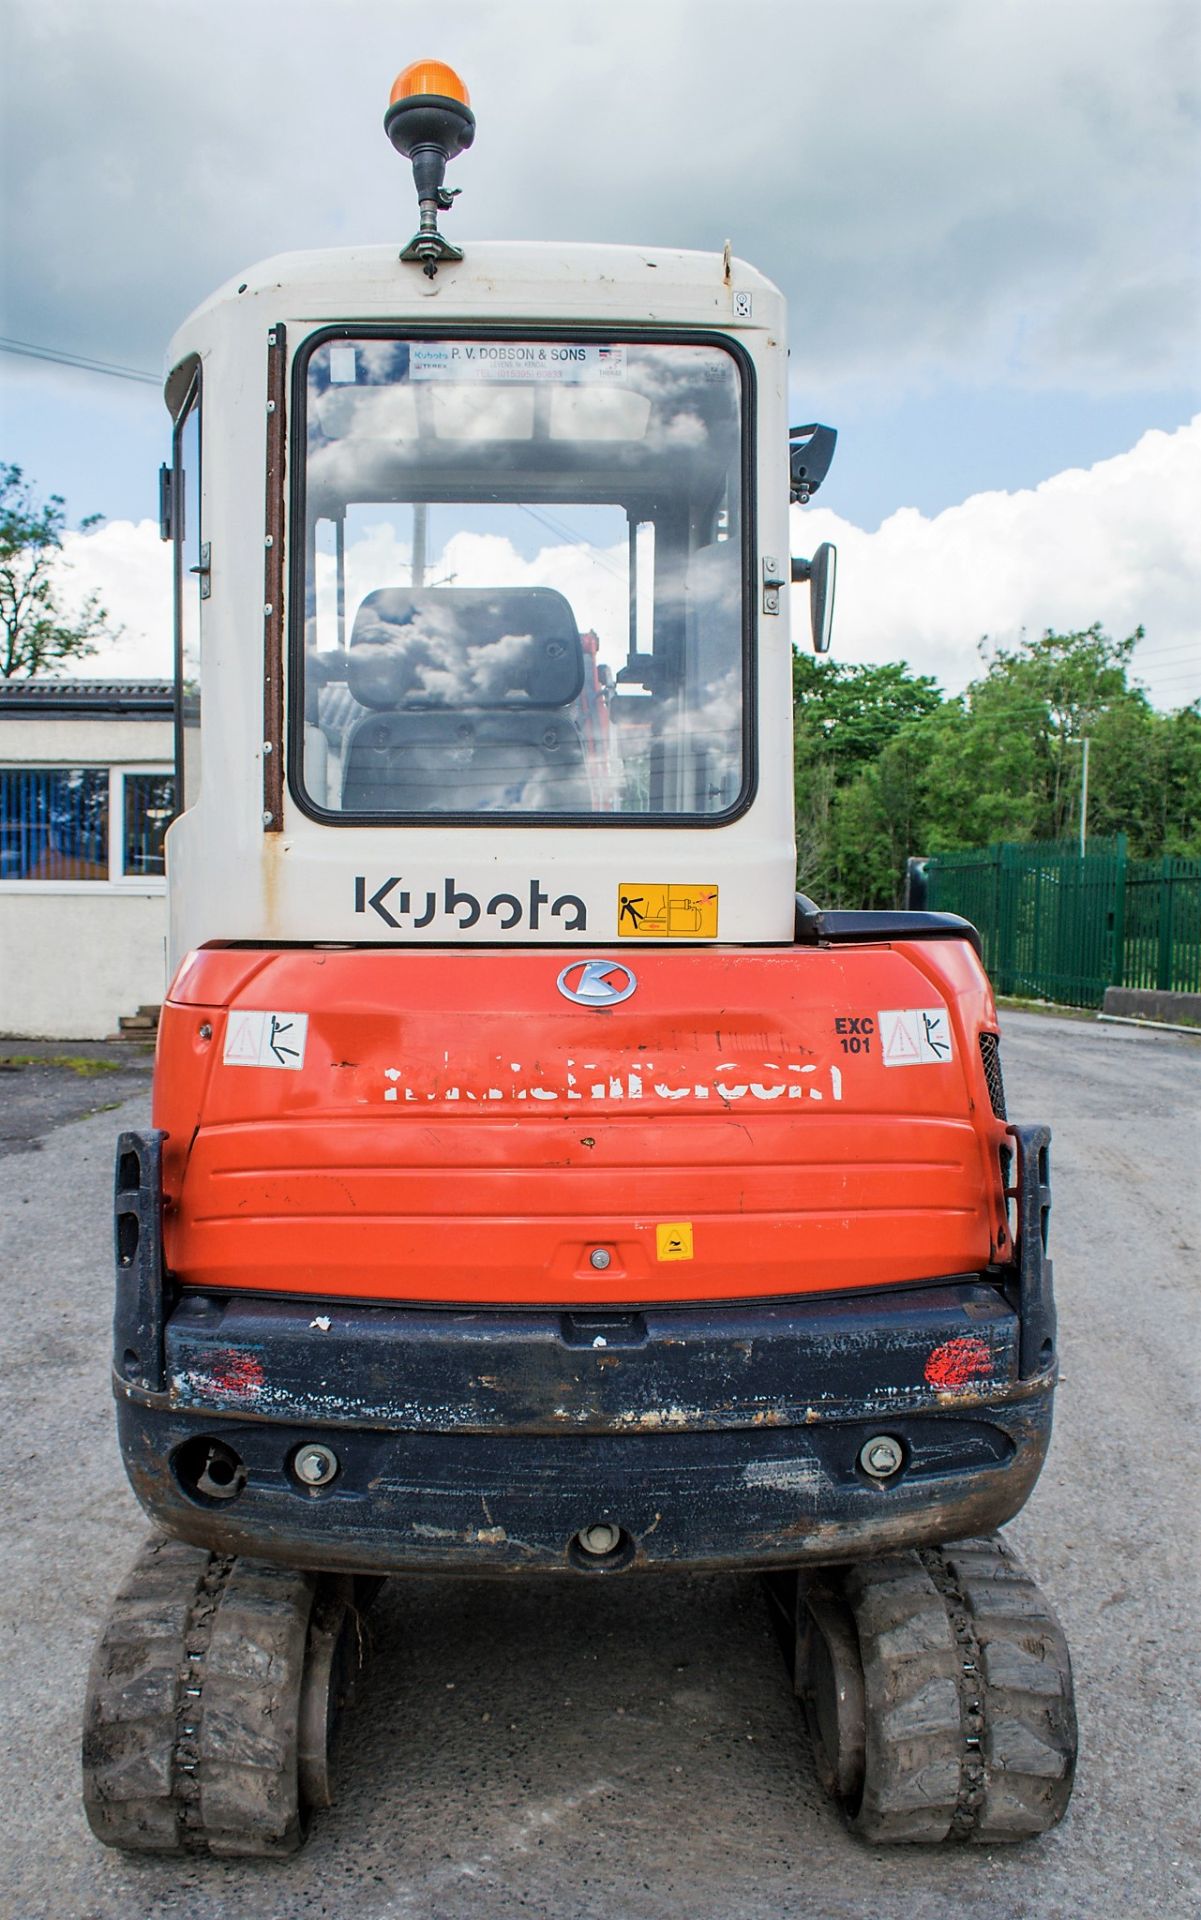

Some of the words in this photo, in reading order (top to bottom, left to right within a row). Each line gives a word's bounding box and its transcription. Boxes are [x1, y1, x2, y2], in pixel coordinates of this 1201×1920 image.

[414, 351, 448, 359] Kubota
[452, 348, 461, 359] P.
[466, 348, 476, 359] V.
[480, 348, 535, 360] DOBSON
[538, 348, 547, 360] &
[551, 348, 586, 361] SONS
[354, 876, 586, 931] Kubota
[834, 1017, 874, 1034] EXC
[840, 1037, 871, 1054] 101
